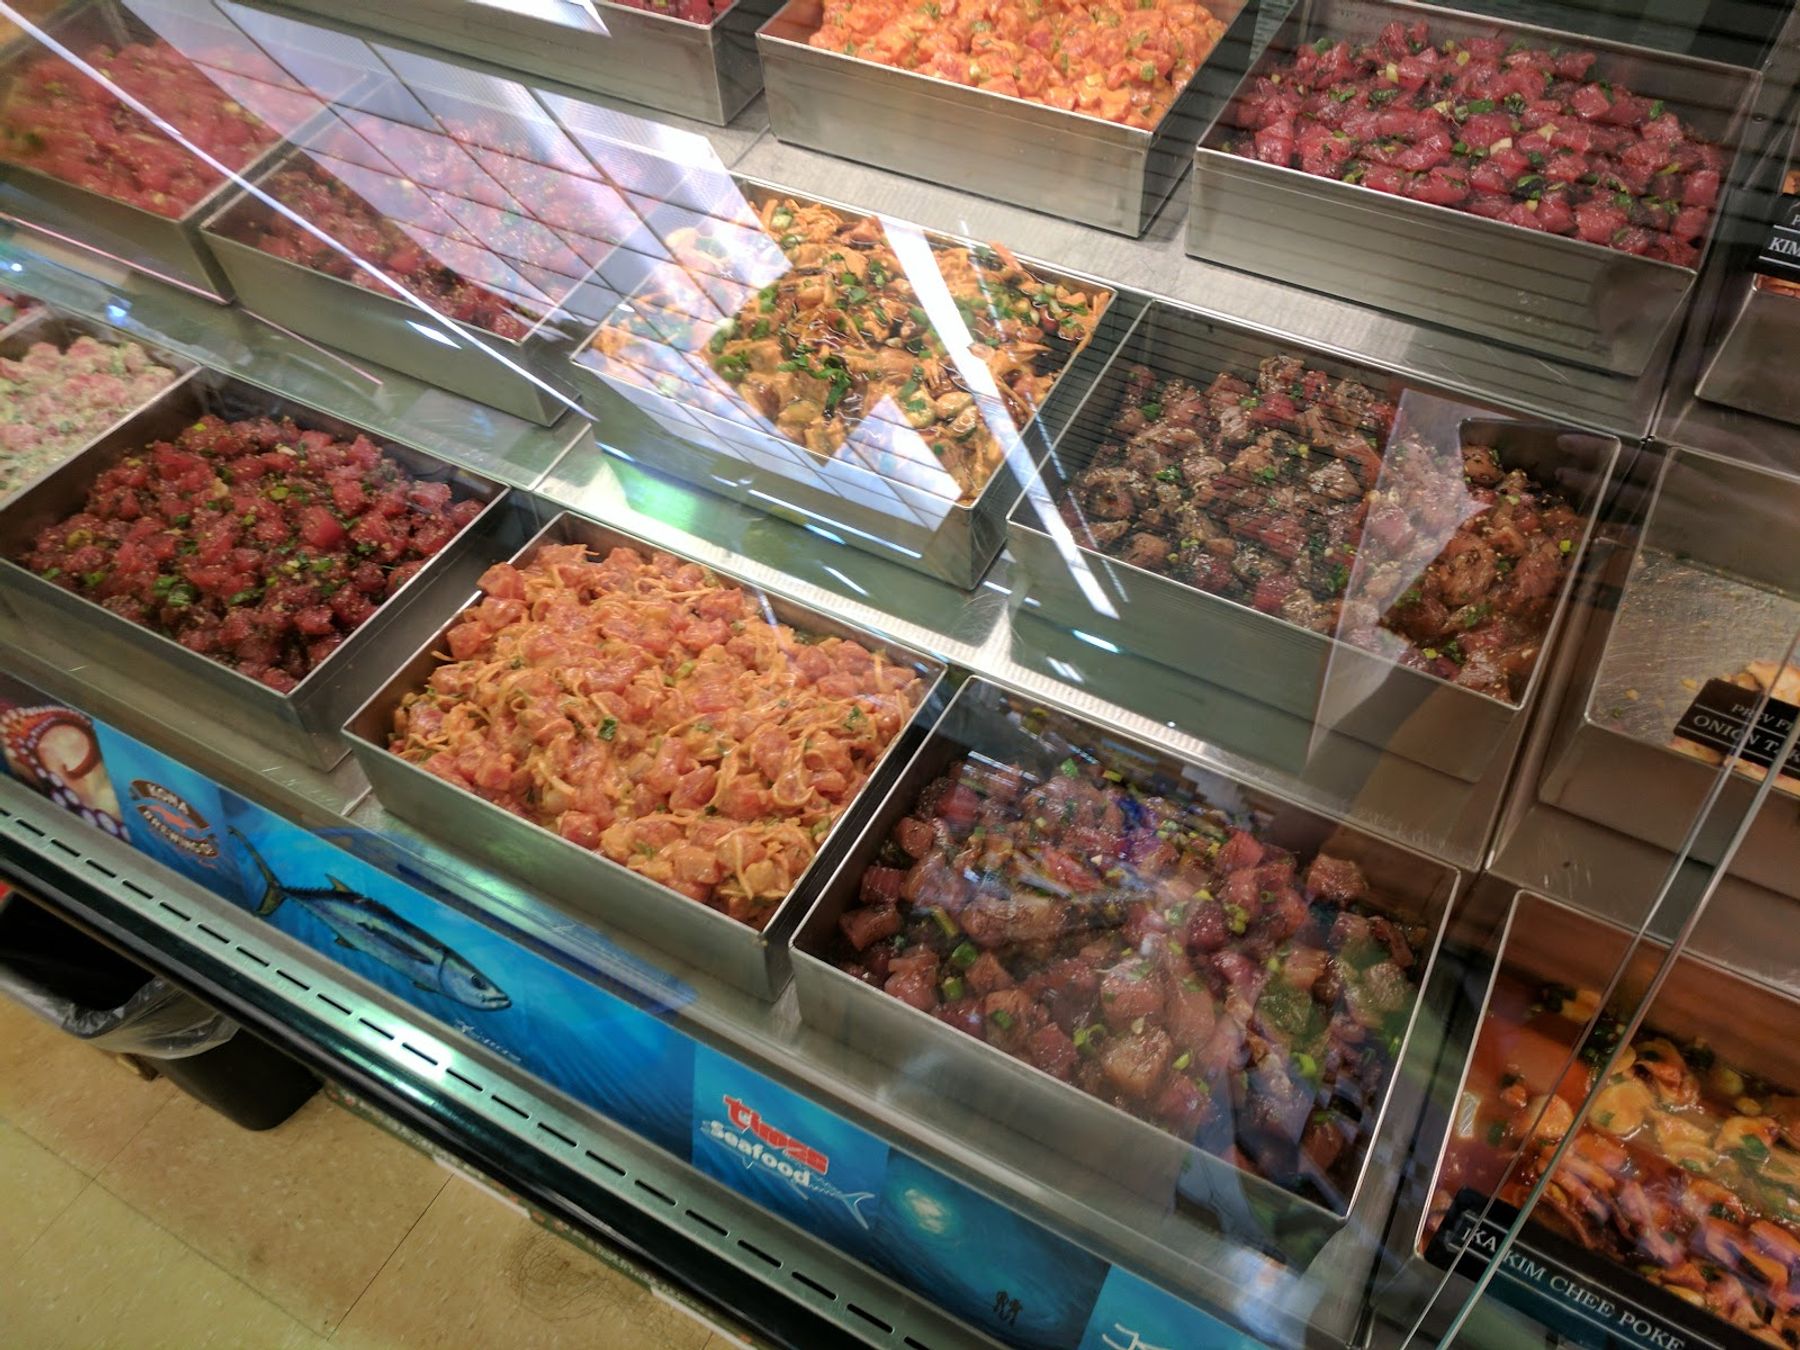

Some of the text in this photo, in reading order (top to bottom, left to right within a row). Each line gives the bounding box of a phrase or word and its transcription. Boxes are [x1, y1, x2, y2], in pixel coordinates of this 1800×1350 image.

[1694, 715, 1760, 745] ONION
[710, 1120, 810, 1187] Seafood
[1503, 1250, 1547, 1281] KIM
[1550, 1275, 1615, 1317] CHEE
